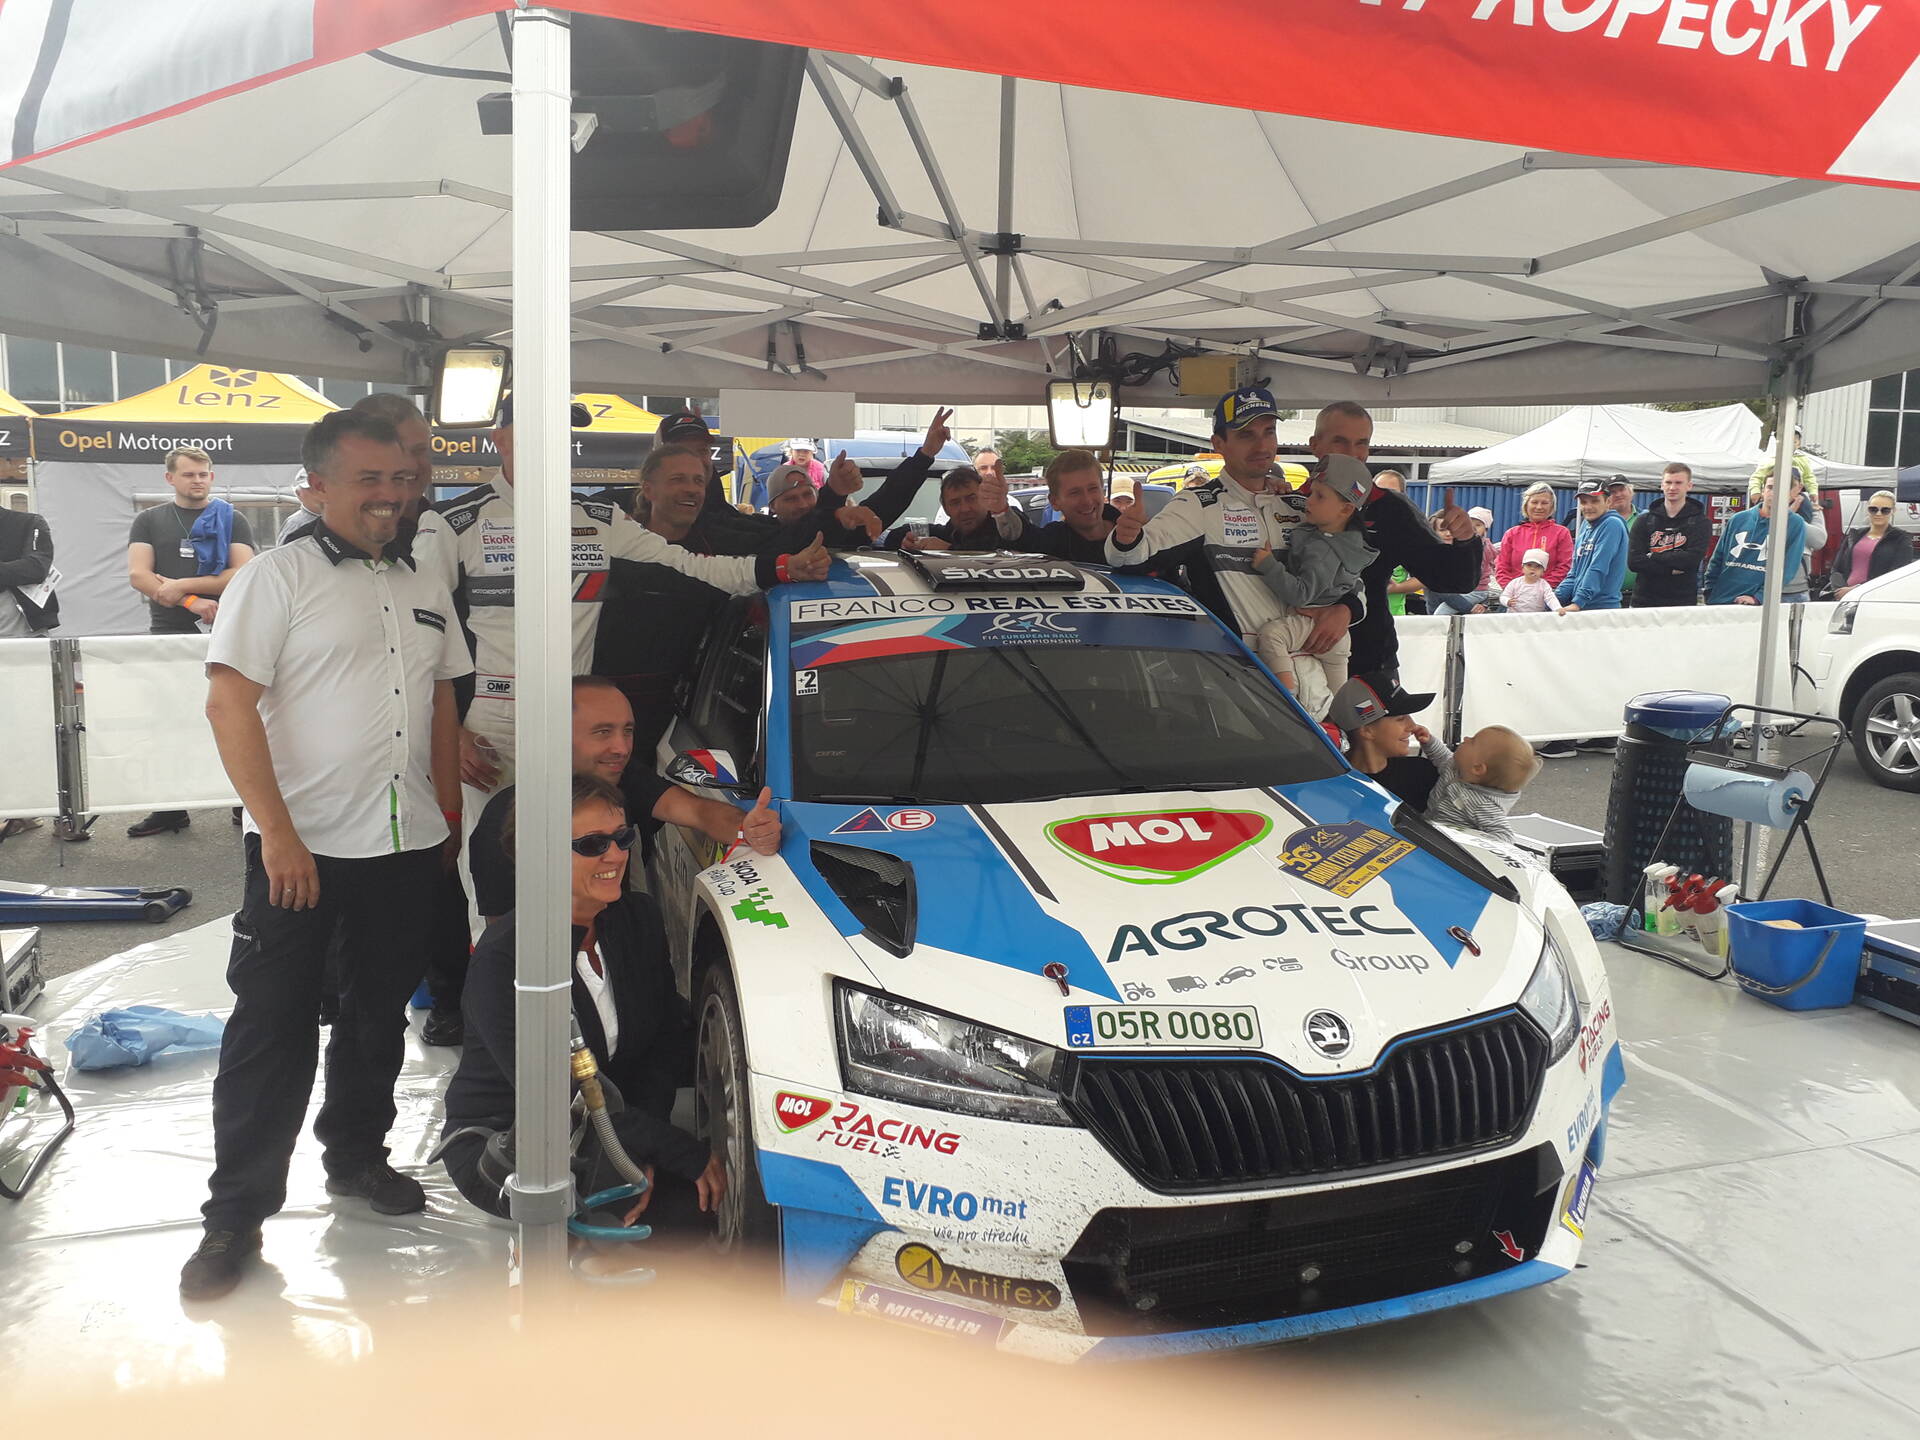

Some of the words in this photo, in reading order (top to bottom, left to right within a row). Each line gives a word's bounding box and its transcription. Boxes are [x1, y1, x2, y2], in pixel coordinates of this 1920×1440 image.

[178, 385, 281, 409] lenz
[59, 430, 112, 452] Opel
[118, 432, 233, 451] Motorsport
[431, 435, 477, 456] Opel
[452, 513, 473, 527] OMP
[1223, 513, 1257, 523] EkoRent
[482, 535, 514, 546] EkoRe
[1225, 527, 1247, 537] EVRO
[571, 544, 604, 552] GROTEC
[941, 566, 1076, 580] ŠKODA
[799, 598, 955, 620] FRANCO
[964, 596, 1059, 611] REAL
[1062, 597, 1197, 613] ESTATES
[1001, 633, 1050, 641] EUROPEAN
[487, 682, 511, 692] OMP
[1089, 816, 1213, 852] MOL
[729, 859, 762, 886] ŠKODA
[717, 880, 736, 896] Cup
[1107, 903, 1414, 963] AGROTEC
[1330, 948, 1430, 975] Group
[1096, 1010, 1160, 1040] 05R
[1168, 1011, 1254, 1041] 0080
[1071, 1033, 1091, 1045] CZ
[779, 1096, 812, 1117] MOL
[831, 1102, 961, 1155] RACING
[1567, 1103, 1590, 1154] EVRO
[816, 1130, 881, 1154] FUEL
[882, 1176, 978, 1221] EVRO
[982, 1195, 1028, 1220] mat
[933, 1226, 952, 1240] vše
[957, 1230, 979, 1243] pro
[980, 1226, 1029, 1245] střechu
[946, 1270, 1053, 1307] Artifex
[884, 1302, 982, 1335] MICHELIN
